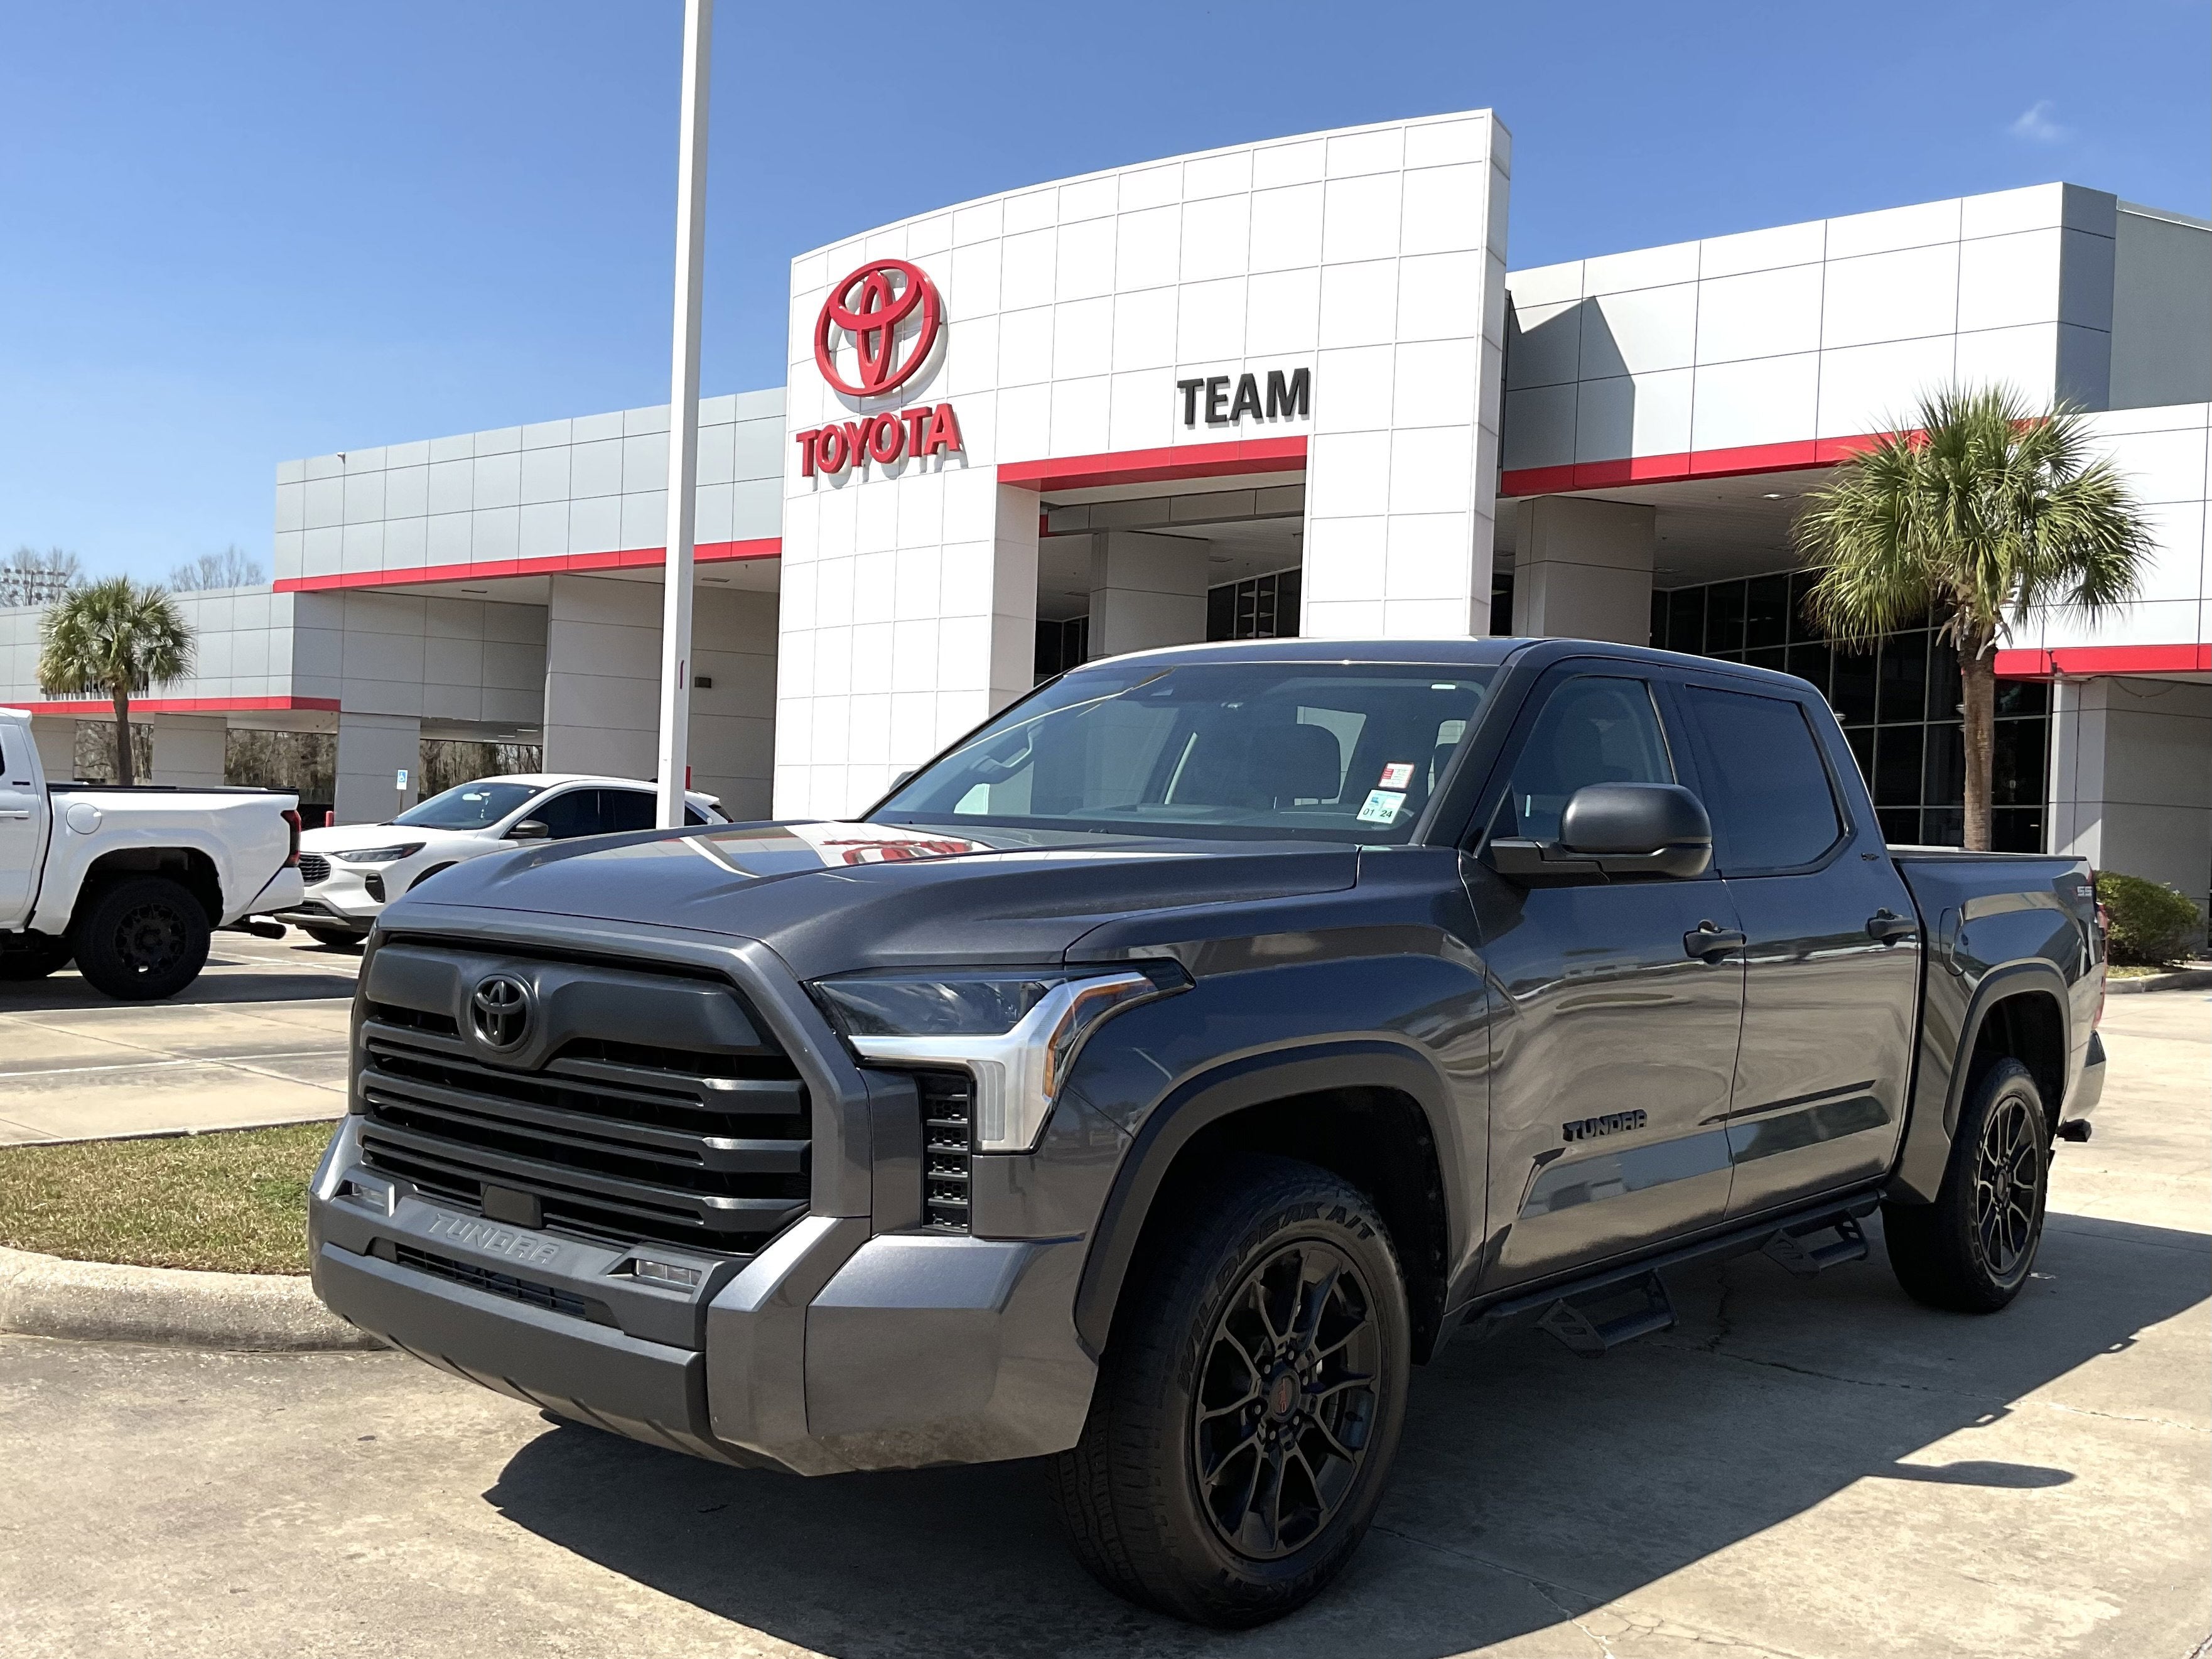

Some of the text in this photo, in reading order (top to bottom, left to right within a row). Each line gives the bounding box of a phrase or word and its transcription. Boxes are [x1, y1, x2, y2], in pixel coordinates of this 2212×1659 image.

[1177, 367, 1311, 426] TEAM
[796, 403, 961, 478] TOYOTA
[1363, 808, 1393, 818] 01 24
[1563, 1109, 1648, 1142] TUNDRA
[428, 1213, 561, 1265] TUNDRA
